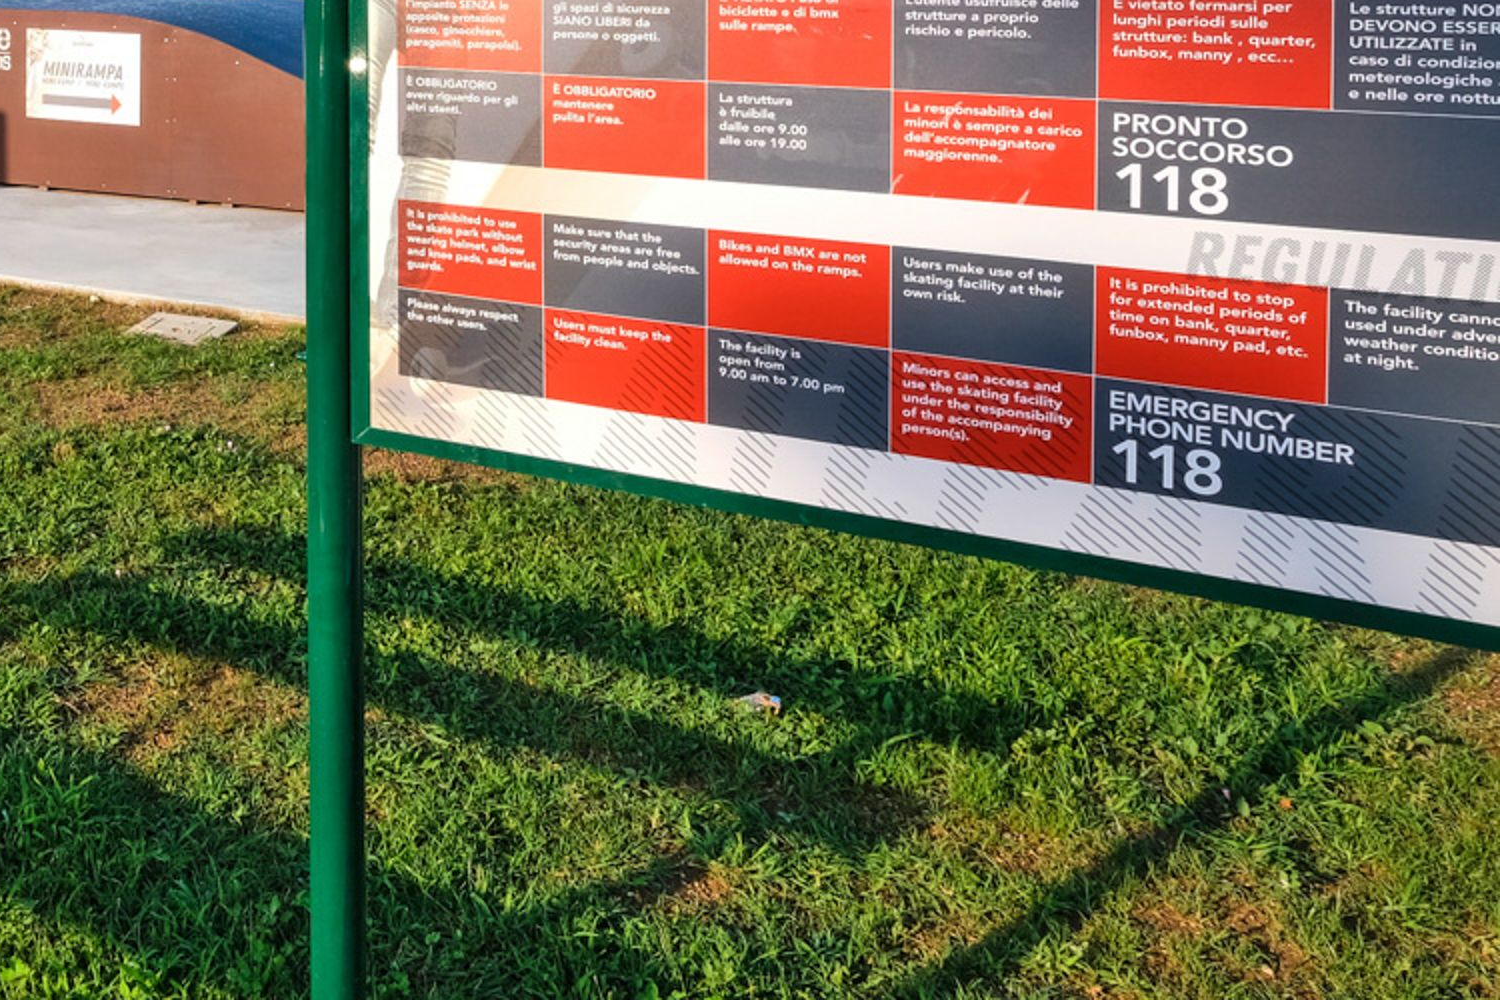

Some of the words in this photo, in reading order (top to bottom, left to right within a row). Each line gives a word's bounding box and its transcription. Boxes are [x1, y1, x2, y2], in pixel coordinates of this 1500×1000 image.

[719, 4, 777, 17] biciclette
[781, 9, 789, 17] e
[793, 6, 806, 18] di
[809, 6, 838, 18] bmx
[905, 10, 966, 21] strutture
[971, 13, 979, 21] a
[983, 11, 1039, 25] proprio
[1262, 3, 1292, 16] per
[1349, 2, 1370, 14] Le
[1375, 4, 1456, 16] strutture
[719, 19, 748, 30] sulle
[751, 22, 796, 34] rampe.
[1113, 13, 1161, 29] lunghi
[1166, 15, 1224, 29] periodi
[1230, 15, 1268, 28] sulle
[1349, 18, 1436, 32] DEVONO
[905, 24, 950, 36] rischio
[953, 27, 963, 36] e
[967, 26, 1031, 39] pericolo.
[1112, 31, 1187, 42] strutture:
[1192, 31, 1232, 44] bank
[1248, 35, 1315, 48] quarter,
[1349, 35, 1453, 50] UTILIZZATE
[1460, 38, 1476, 51] in
[1112, 44, 1172, 60] funbox,
[1177, 50, 1232, 64] manny
[1247, 52, 1293, 62] ecc...
[1349, 55, 1388, 66] caso
[1394, 53, 1411, 66] di
[43, 61, 123, 81] MINIRAMPA
[1349, 72, 1492, 88] metereologiche
[719, 92, 733, 102] La
[736, 94, 792, 106] struttura
[1348, 89, 1359, 98] e
[1365, 87, 1408, 100] nelle
[1413, 92, 1444, 102] ore
[718, 106, 727, 116] è
[729, 106, 775, 120] fruibile
[904, 101, 920, 112] La
[923, 101, 1024, 118] responsabilità
[1028, 107, 1052, 120] dei
[718, 120, 749, 132] dalle
[752, 125, 774, 134] ore
[777, 123, 808, 136] 9.00
[903, 115, 950, 128] minori
[952, 119, 962, 130] è
[965, 122, 1020, 135] sempre
[1023, 125, 1033, 134] a
[1037, 125, 1082, 137] carico
[1113, 112, 1248, 140] PRONTO
[719, 134, 741, 146] alle
[744, 138, 766, 147] ore
[770, 137, 806, 150] 19.00
[903, 131, 1056, 151] dell'accompagnatore
[903, 148, 1002, 162] maggiorenne.
[1112, 136, 1293, 167] SOCCORSO
[1115, 163, 1229, 215] 118
[719, 239, 752, 252] Bikes
[755, 244, 780, 254] and
[783, 245, 814, 258] BMX
[818, 251, 840, 260] are
[843, 253, 866, 263] not
[718, 253, 768, 268] allowed
[771, 261, 788, 269] on
[791, 260, 814, 272] the
[817, 265, 862, 278] ramps.
[903, 256, 942, 270] Users
[945, 262, 984, 274] make
[988, 267, 1013, 278] use
[1017, 267, 1034, 280] of
[1037, 269, 1062, 283] the
[903, 271, 953, 290] skating
[957, 276, 1004, 295] facility
[1009, 284, 1024, 294] at
[1027, 283, 1064, 298] their
[1109, 277, 1121, 289] It
[1125, 278, 1138, 290] is
[1142, 282, 1228, 300] prohibited
[1233, 291, 1251, 302] to
[1255, 293, 1294, 308] stop
[903, 289, 932, 299] own
[936, 290, 965, 302] risk.
[1109, 291, 1132, 305] for
[1137, 298, 1214, 314] extended
[1219, 307, 1283, 322] periods
[1287, 311, 1307, 324] of
[1344, 299, 1377, 314] The
[1383, 303, 1443, 324] facility
[1109, 309, 1144, 323] time
[1149, 315, 1169, 326] on
[1174, 315, 1219, 332] bank,
[1224, 323, 1290, 340] quarter,
[1345, 320, 1386, 332] used
[1392, 323, 1446, 338] under
[1451, 328, 1500, 343] adve
[718, 338, 742, 351] The
[745, 341, 788, 360] facility
[790, 347, 801, 359] is
[1109, 323, 1168, 343] funbox,
[1174, 334, 1228, 351] manny
[1233, 340, 1270, 355] pad,
[1275, 345, 1307, 357] etc.
[1343, 337, 1418, 352] weather
[718, 355, 751, 366] open
[753, 356, 784, 371] from
[1343, 353, 1361, 364] at
[1367, 353, 1418, 370] night.
[718, 366, 746, 380] 9.00
[749, 373, 770, 382] am
[772, 375, 787, 385] to
[790, 375, 820, 390] 7.00
[823, 383, 844, 393] pm
[902, 361, 950, 378] Minors
[953, 371, 979, 382] can
[982, 375, 1030, 389] access
[1033, 381, 1061, 393] and
[901, 379, 926, 390] use
[929, 380, 953, 394] the
[957, 384, 1009, 404] skating
[1013, 391, 1062, 411] facility
[901, 394, 943, 406] under
[947, 397, 970, 411] the
[974, 403, 1073, 428] responsibility
[1109, 390, 1295, 432] EMERGENCY
[901, 406, 917, 418] of
[920, 409, 944, 422] the
[947, 415, 1051, 440] accompanying
[901, 423, 969, 441] person(s).
[1109, 413, 1212, 445] PHONE
[1221, 429, 1354, 465] NUMBER
[1112, 439, 1223, 496] 118
